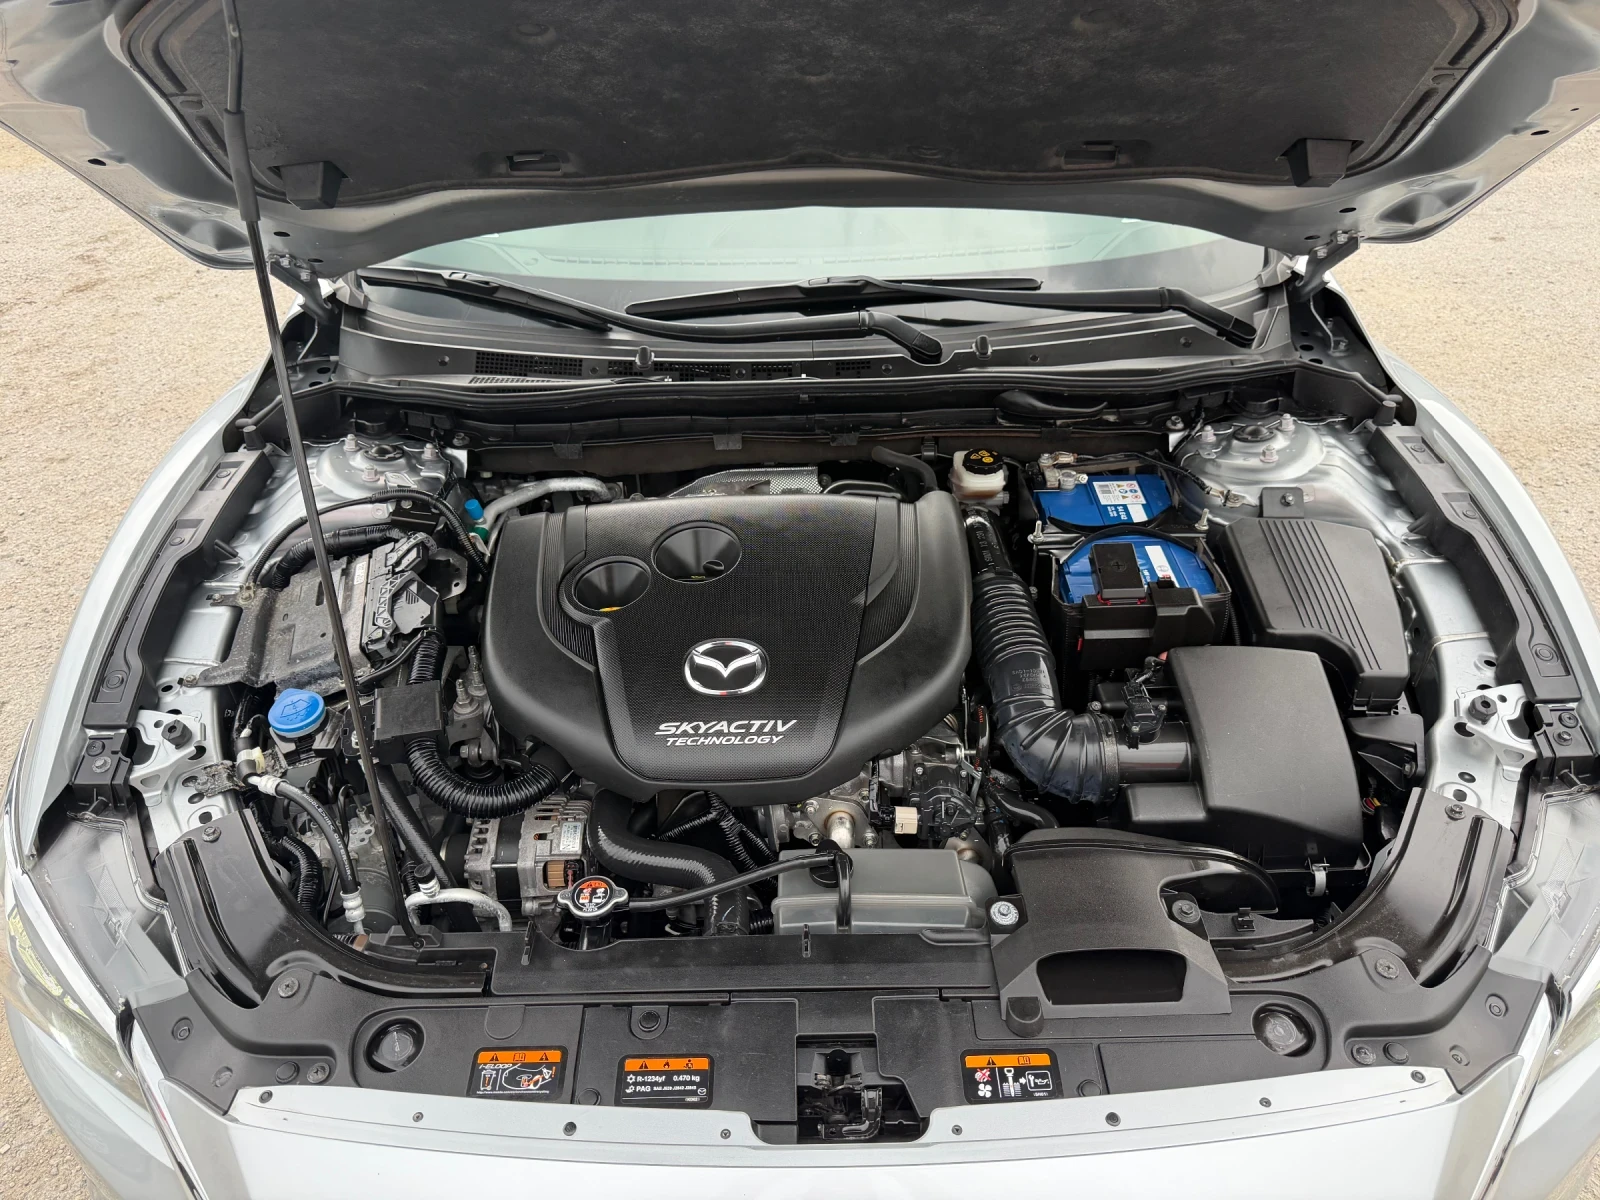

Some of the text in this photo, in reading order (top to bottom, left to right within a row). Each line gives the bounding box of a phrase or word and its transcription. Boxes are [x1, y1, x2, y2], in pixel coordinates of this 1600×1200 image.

[654, 719, 798, 735] SKYACTIV
[666, 735, 784, 746] TECHNOLOGY
[636, 1075, 666, 1083] R-1234yf
[691, 1075, 700, 1083] kg
